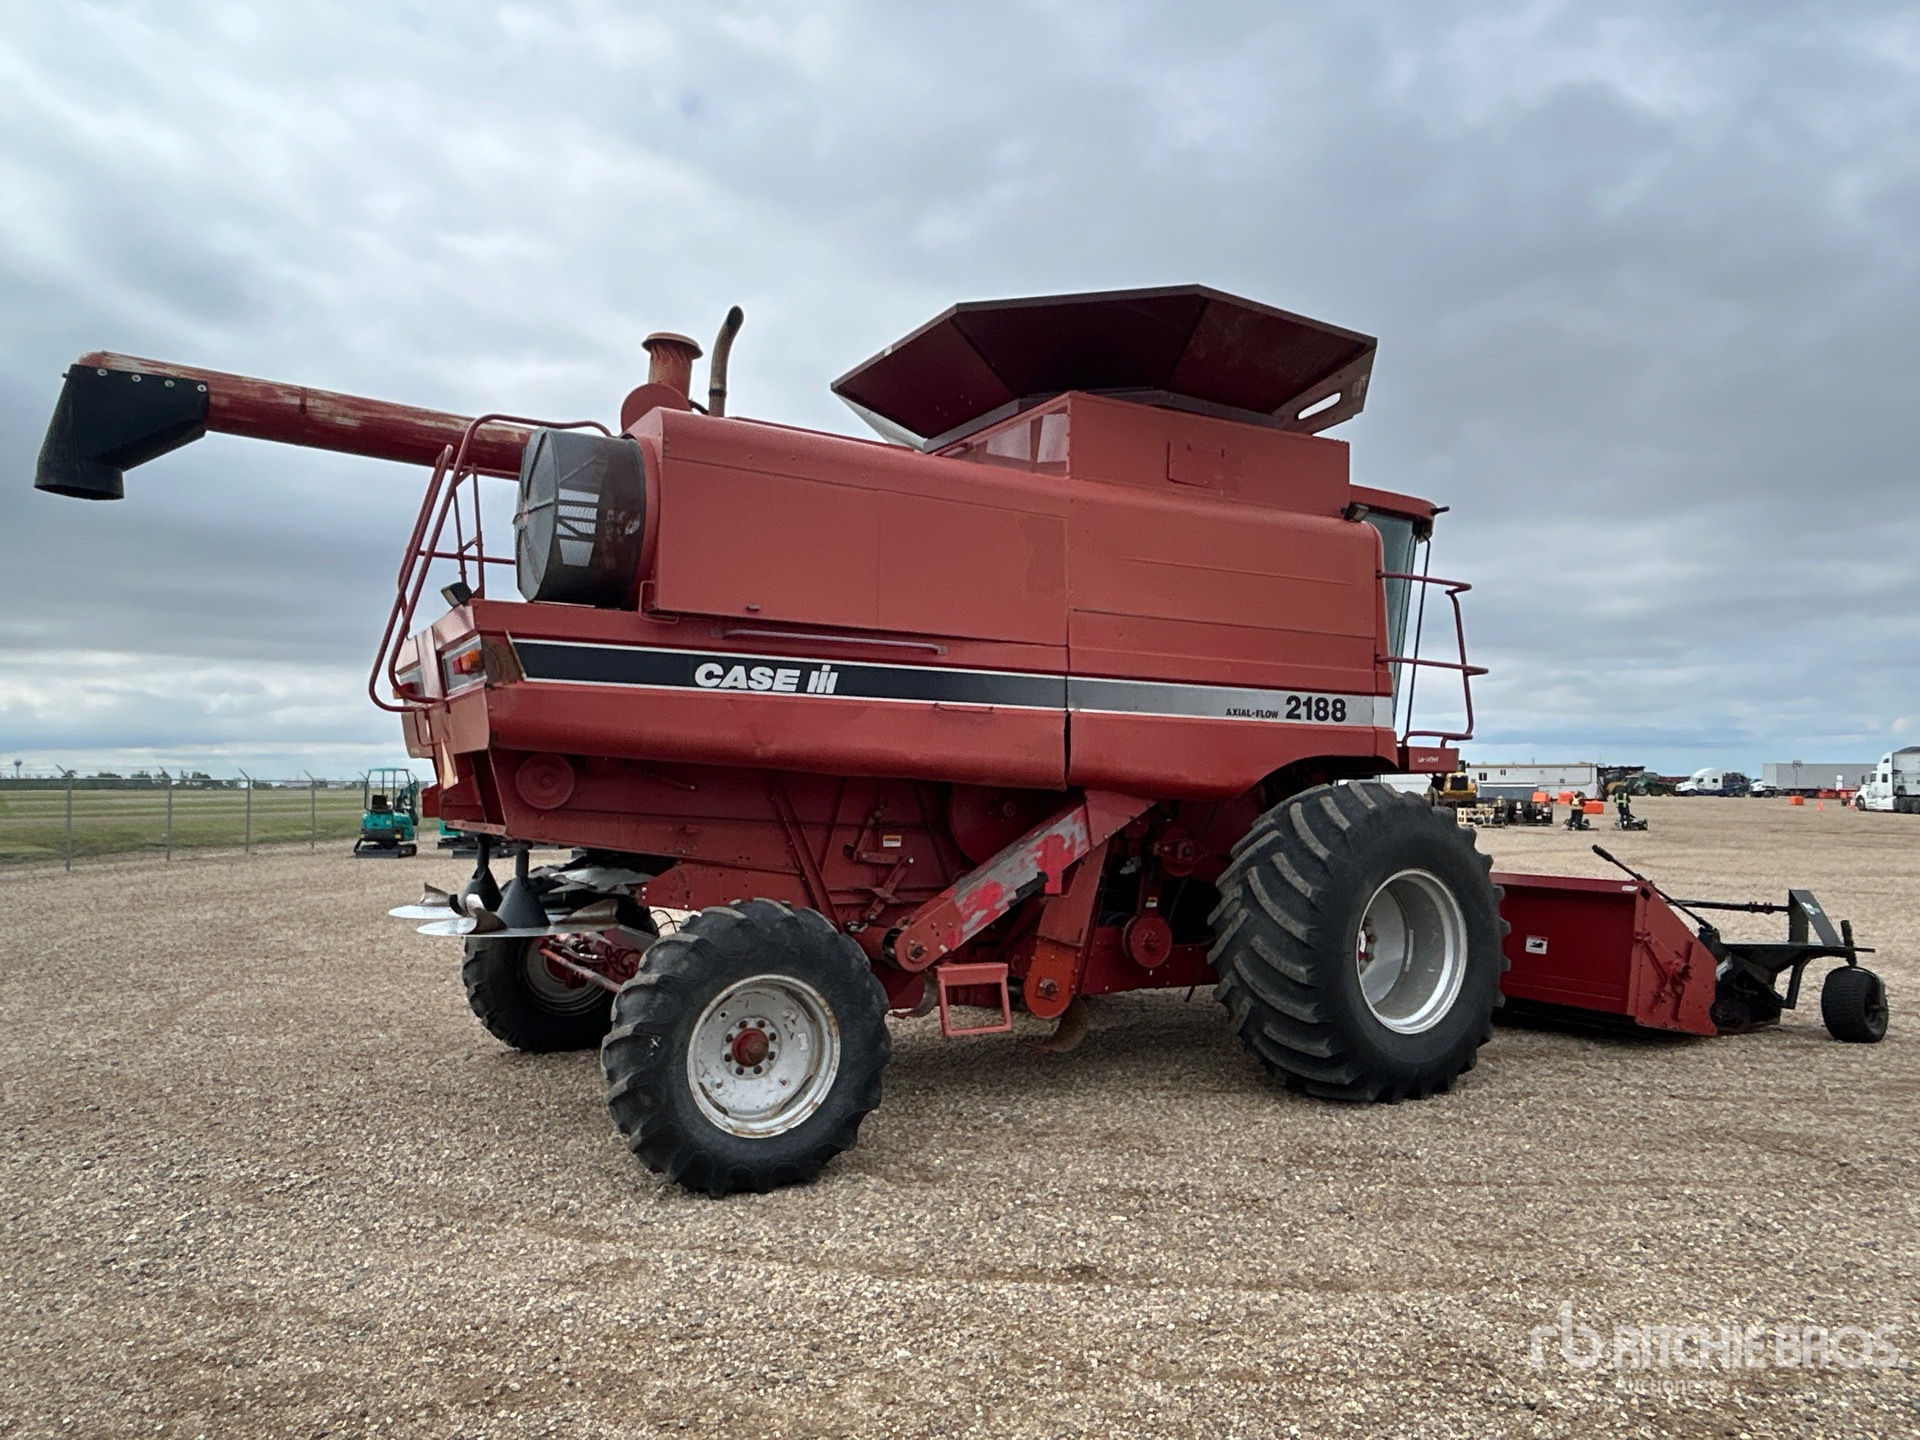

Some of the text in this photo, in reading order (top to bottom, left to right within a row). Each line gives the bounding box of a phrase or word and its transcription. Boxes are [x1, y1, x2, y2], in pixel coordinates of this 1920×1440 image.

[695, 662, 801, 692] CASE
[1226, 695, 1347, 722] AXIAL-FLOW 2188
